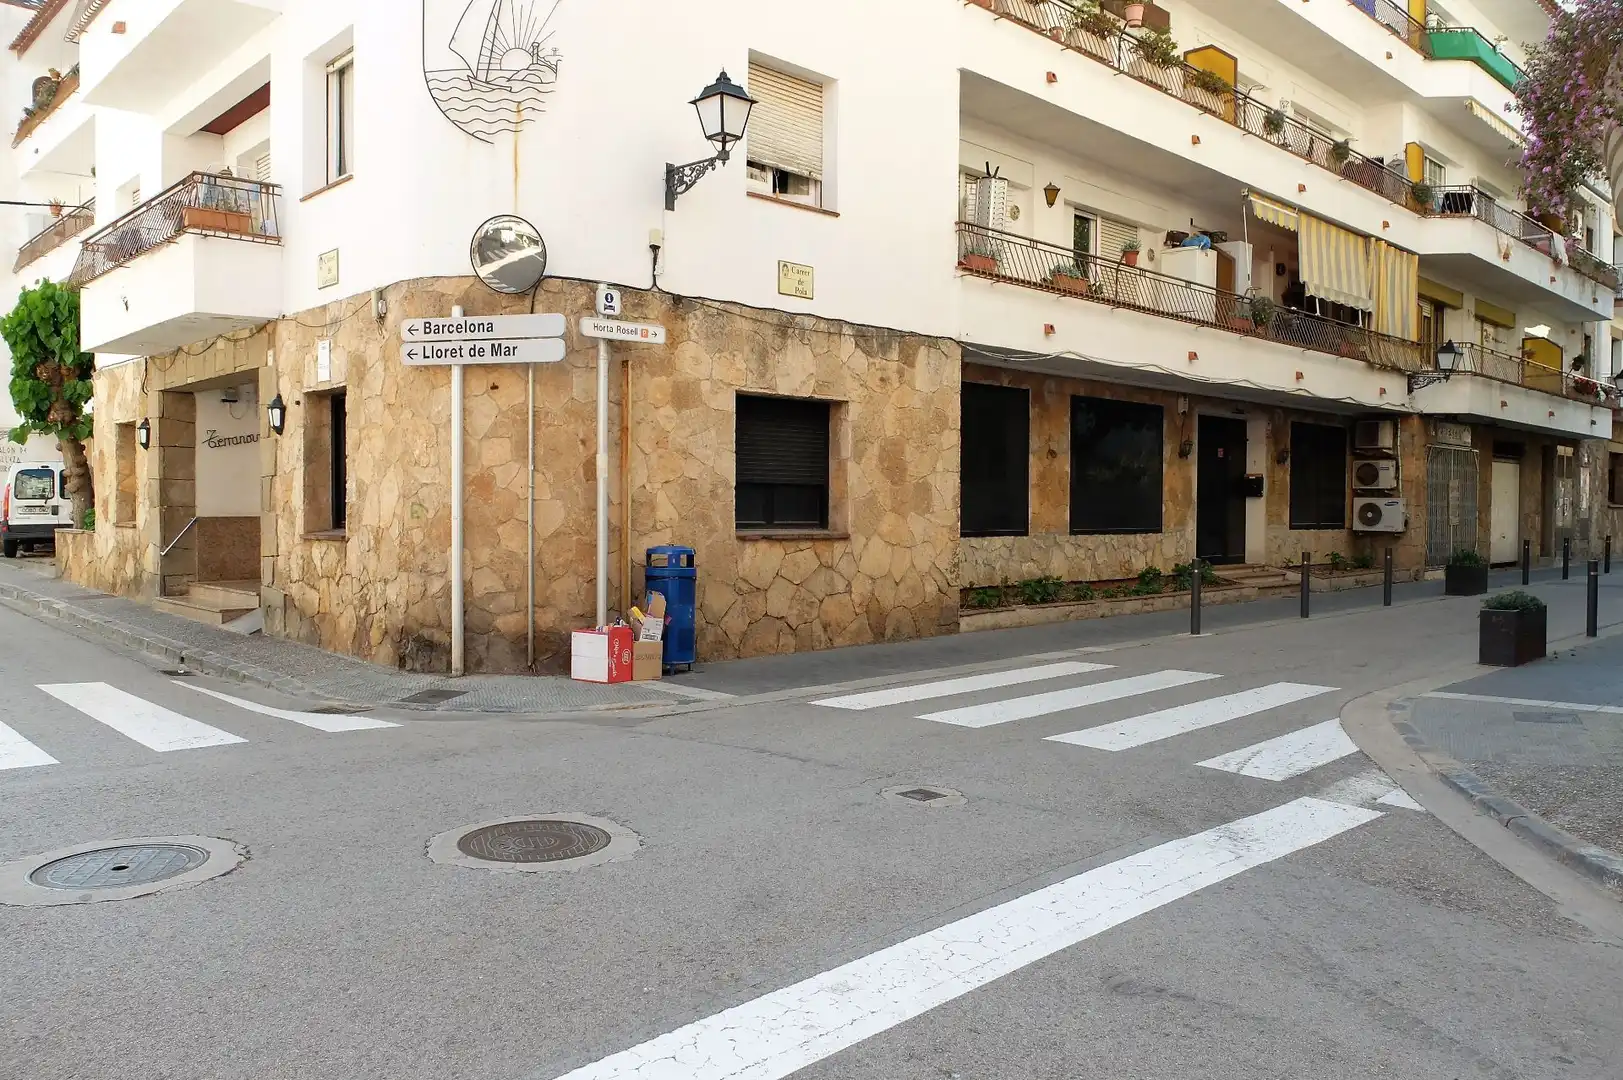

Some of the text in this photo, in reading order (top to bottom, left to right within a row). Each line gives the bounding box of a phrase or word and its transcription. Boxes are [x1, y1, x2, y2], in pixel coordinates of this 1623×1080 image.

[791, 266, 810, 276] Carrer
[797, 278, 804, 286] de
[423, 321, 494, 335] Barcelona
[593, 322, 614, 333] Horta
[616, 325, 639, 336] Rosell
[422, 343, 518, 359] Lloret de Mar
